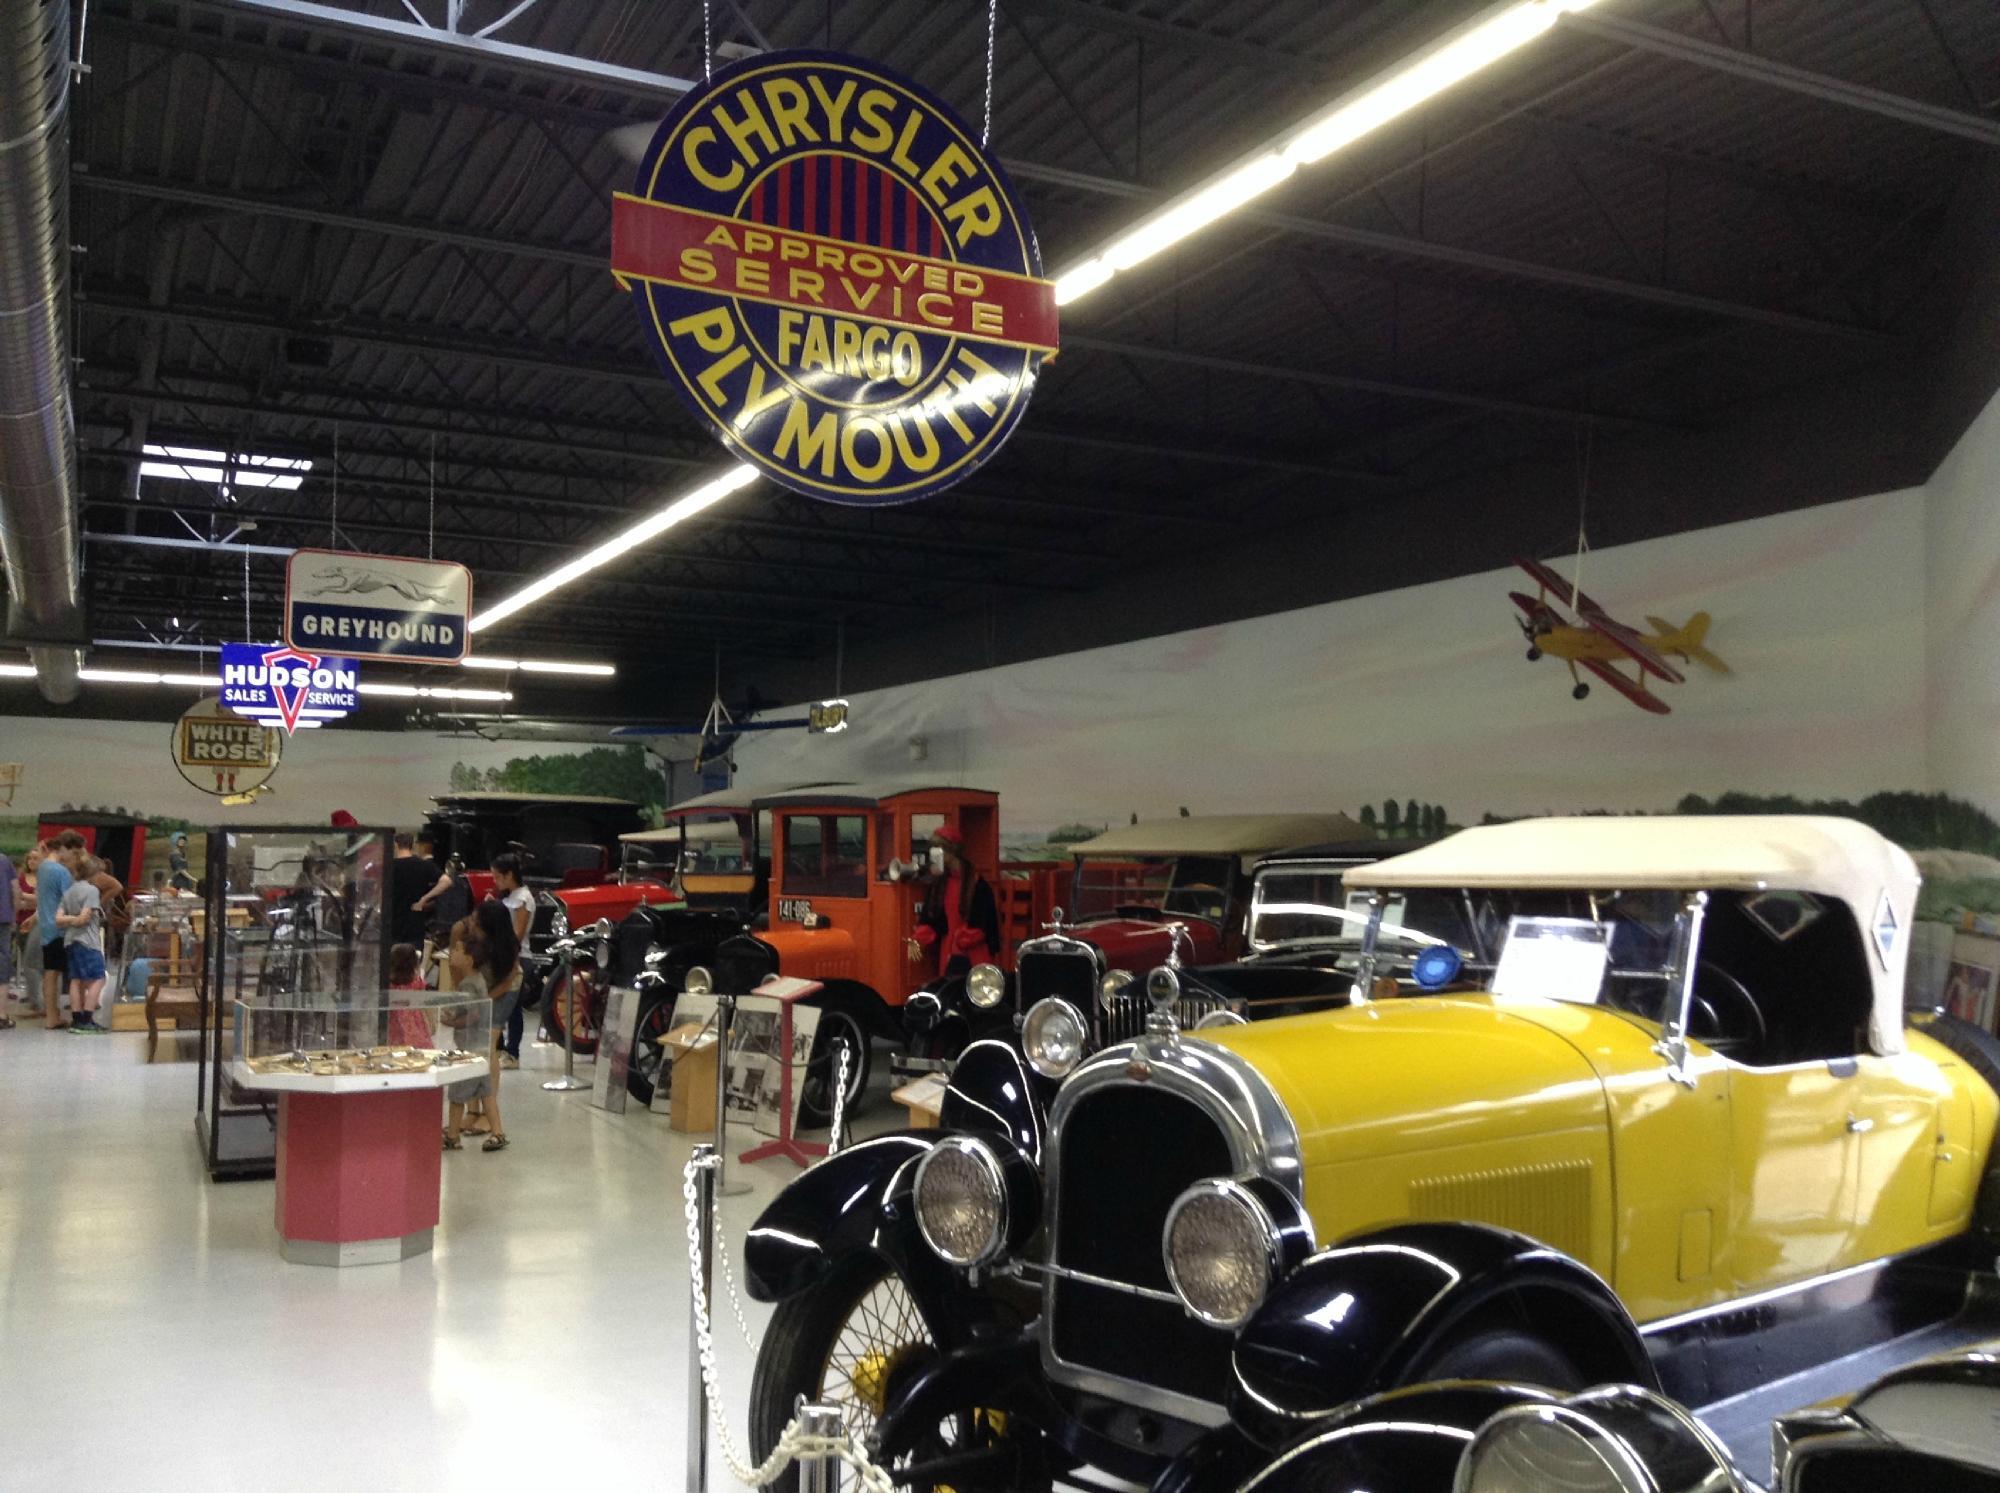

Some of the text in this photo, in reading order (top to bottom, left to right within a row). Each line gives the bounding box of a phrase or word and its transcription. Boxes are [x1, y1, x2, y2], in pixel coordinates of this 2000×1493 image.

[683, 75, 1001, 248] CHRYSLER
[704, 225, 984, 296] APPROVED
[679, 249, 1004, 335] SERVICE
[778, 309, 922, 387] FARGO
[669, 306, 1010, 483] PLYMOUTH
[302, 614, 454, 645] GREYHOUND
[225, 664, 356, 690] HUDSON
[225, 688, 355, 706] SALES SERVICE
[191, 724, 262, 742] WHITE
[194, 742, 259, 760] ROSE
